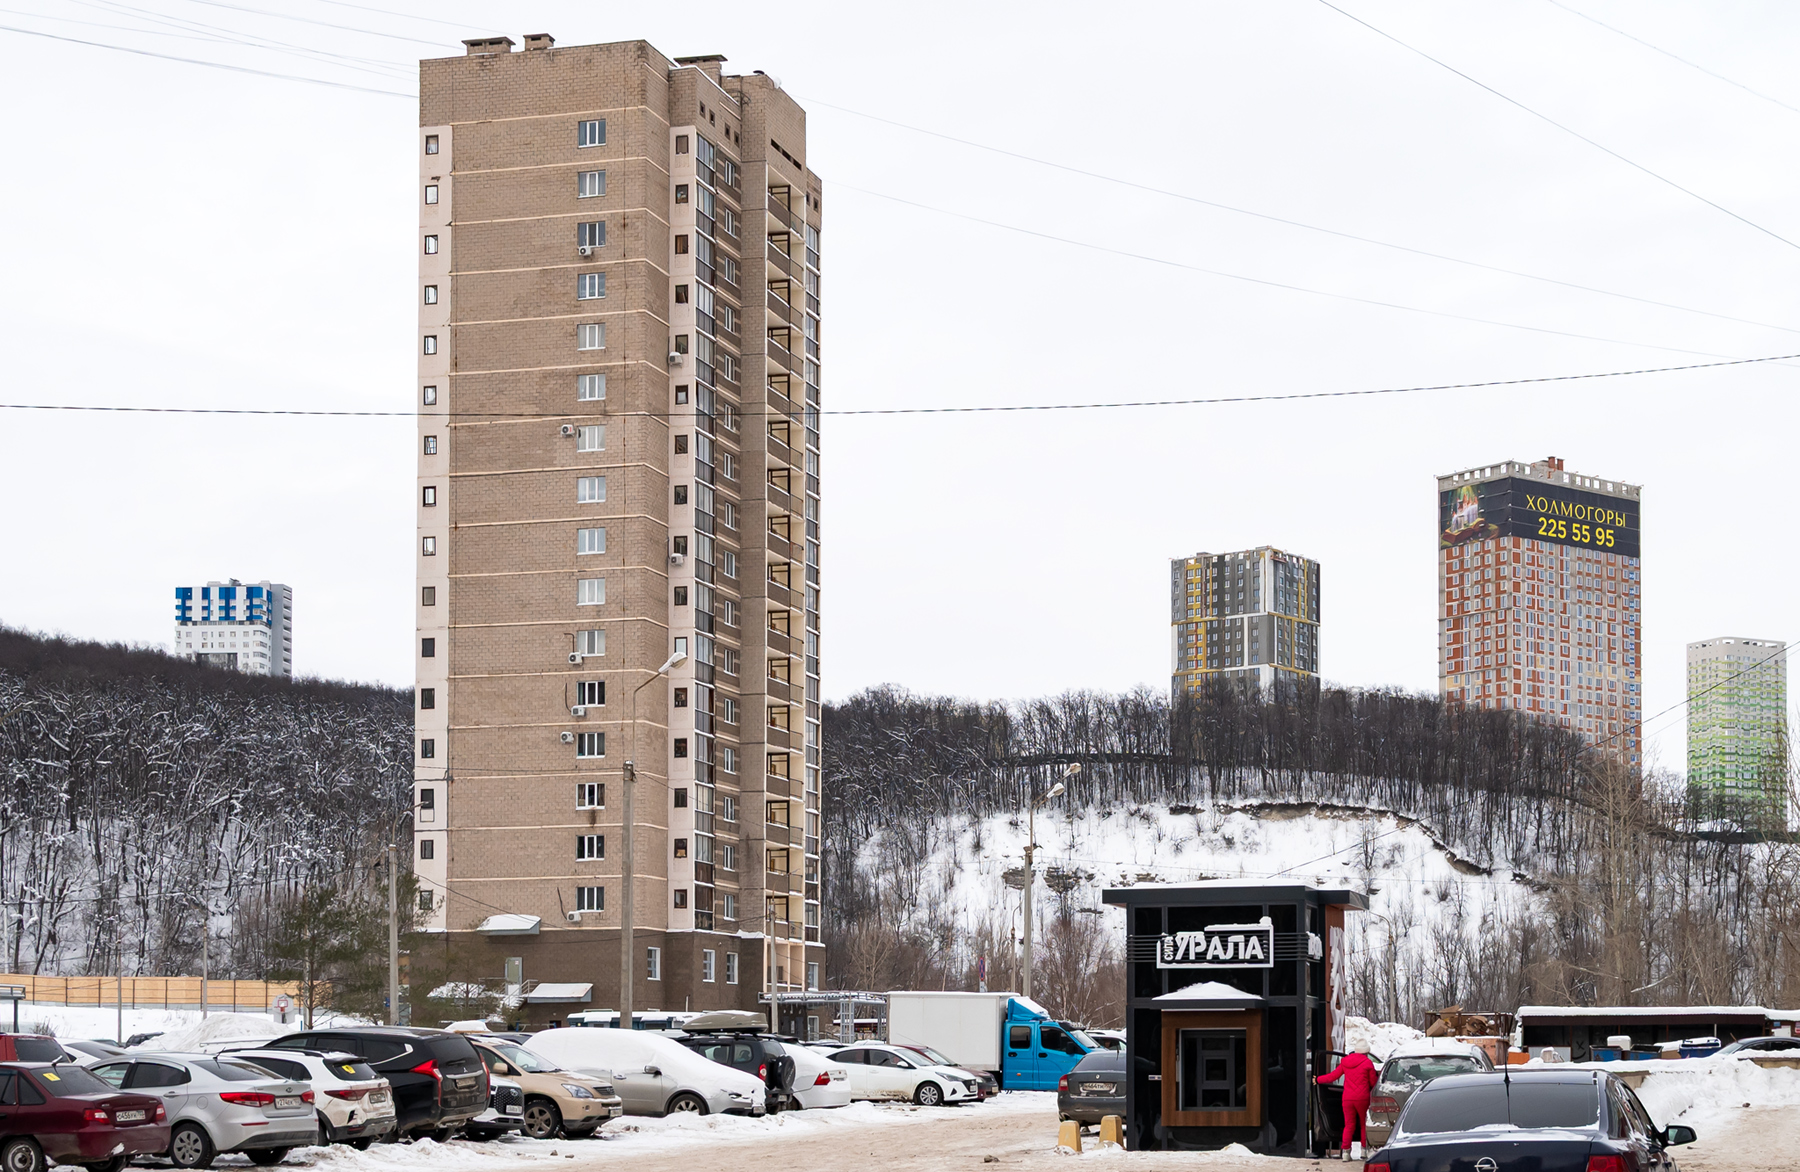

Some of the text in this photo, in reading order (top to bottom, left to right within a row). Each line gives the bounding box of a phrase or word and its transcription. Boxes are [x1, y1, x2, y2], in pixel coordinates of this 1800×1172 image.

[1526, 494, 1626, 528] ХОЛМОГОРЫ
[1538, 516, 1615, 548] 225 55 95
[1164, 935, 1174, 961] СИЛА
[1175, 932, 1265, 960] УРАЛА
